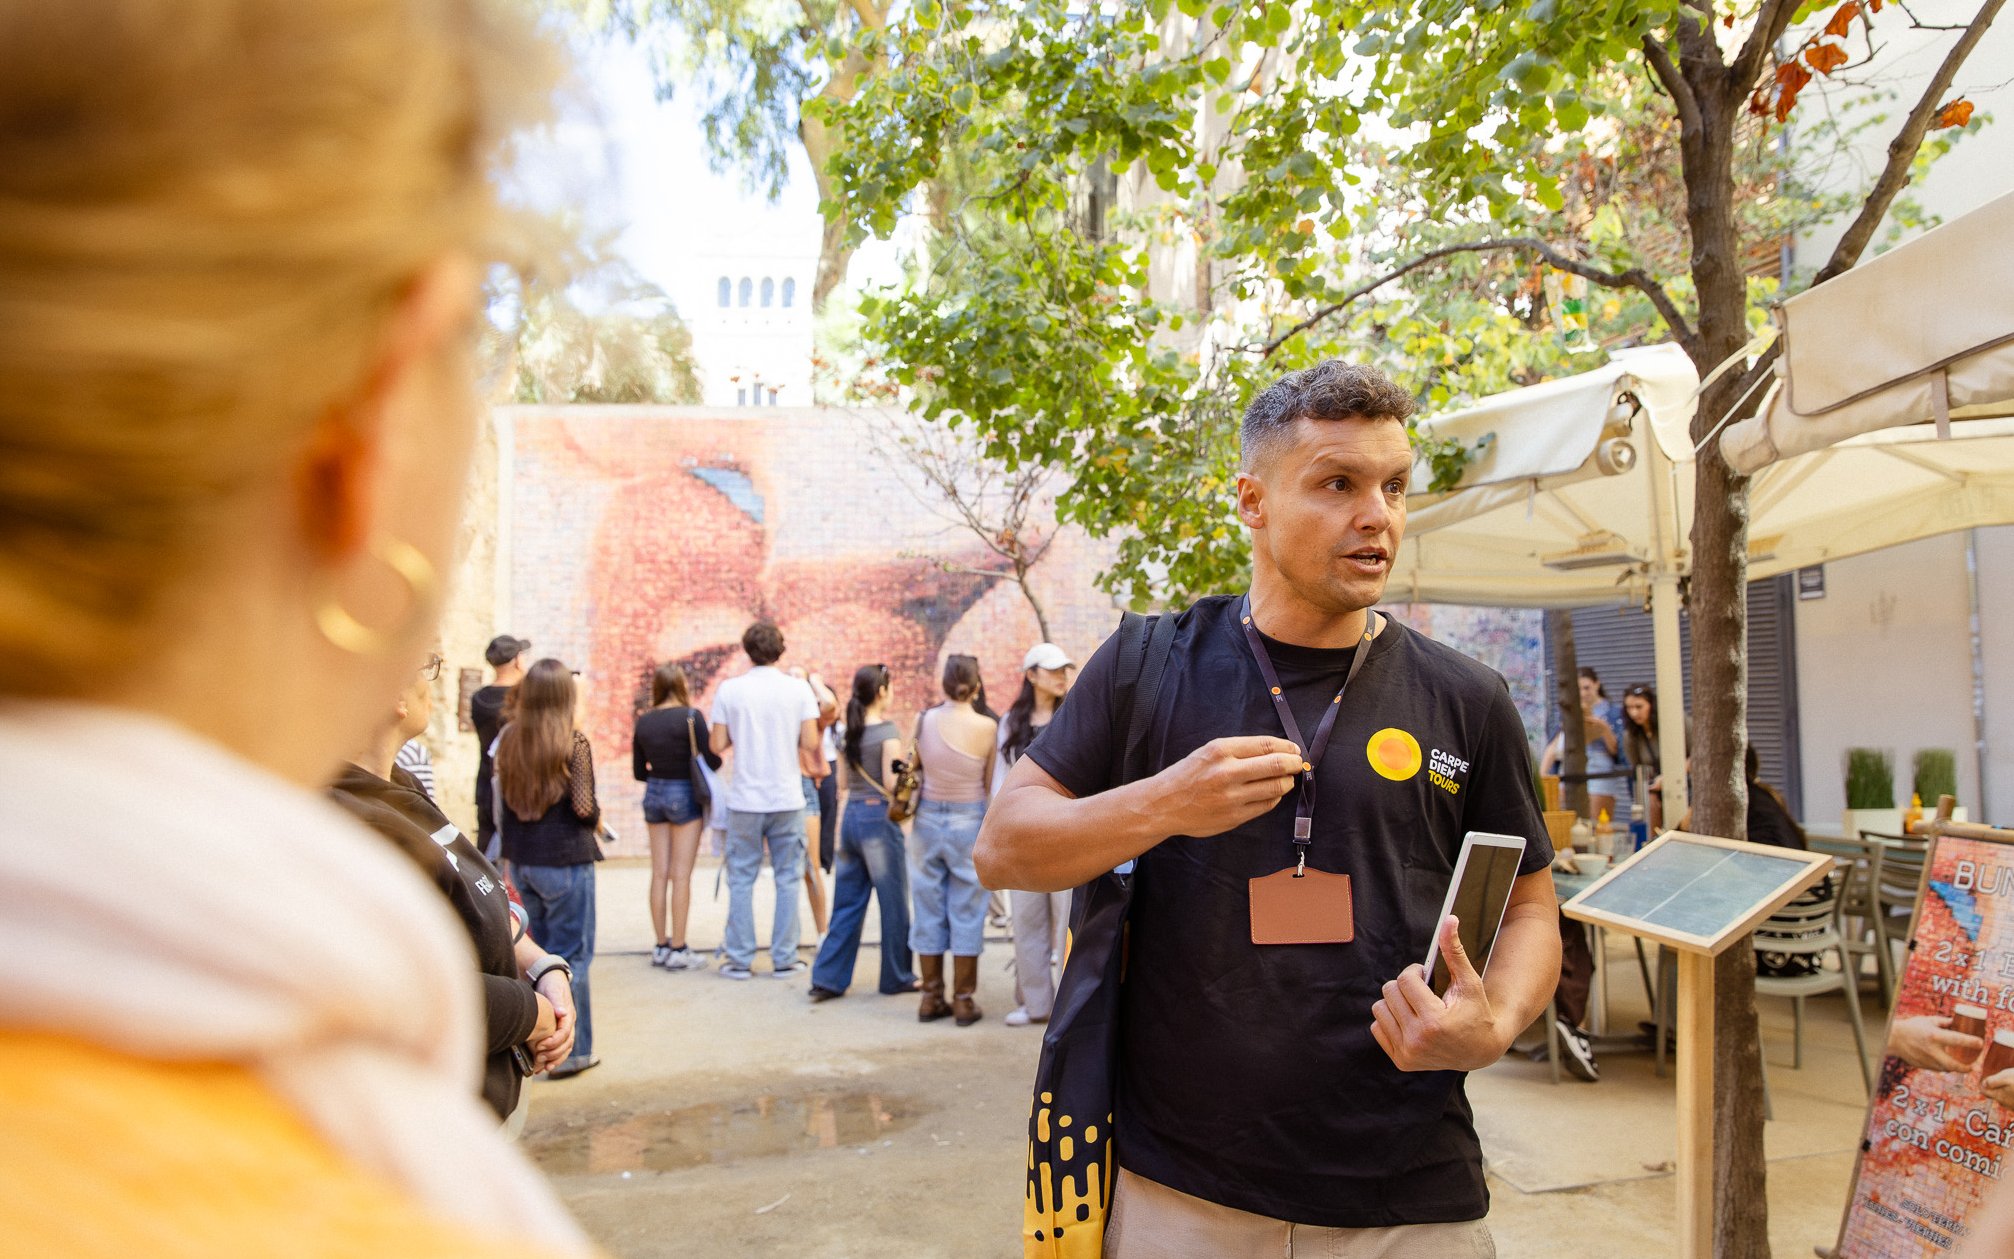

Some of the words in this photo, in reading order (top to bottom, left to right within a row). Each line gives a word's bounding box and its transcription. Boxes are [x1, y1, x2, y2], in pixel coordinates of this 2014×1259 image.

[1429, 759, 1456, 779] DIEM
[1430, 748, 1469, 773] CARPE
[1428, 769, 1460, 795] TOURS
[1932, 974, 1990, 1005] with
[1884, 1119, 1929, 1151] con
[1934, 1138, 2006, 1181] comi
